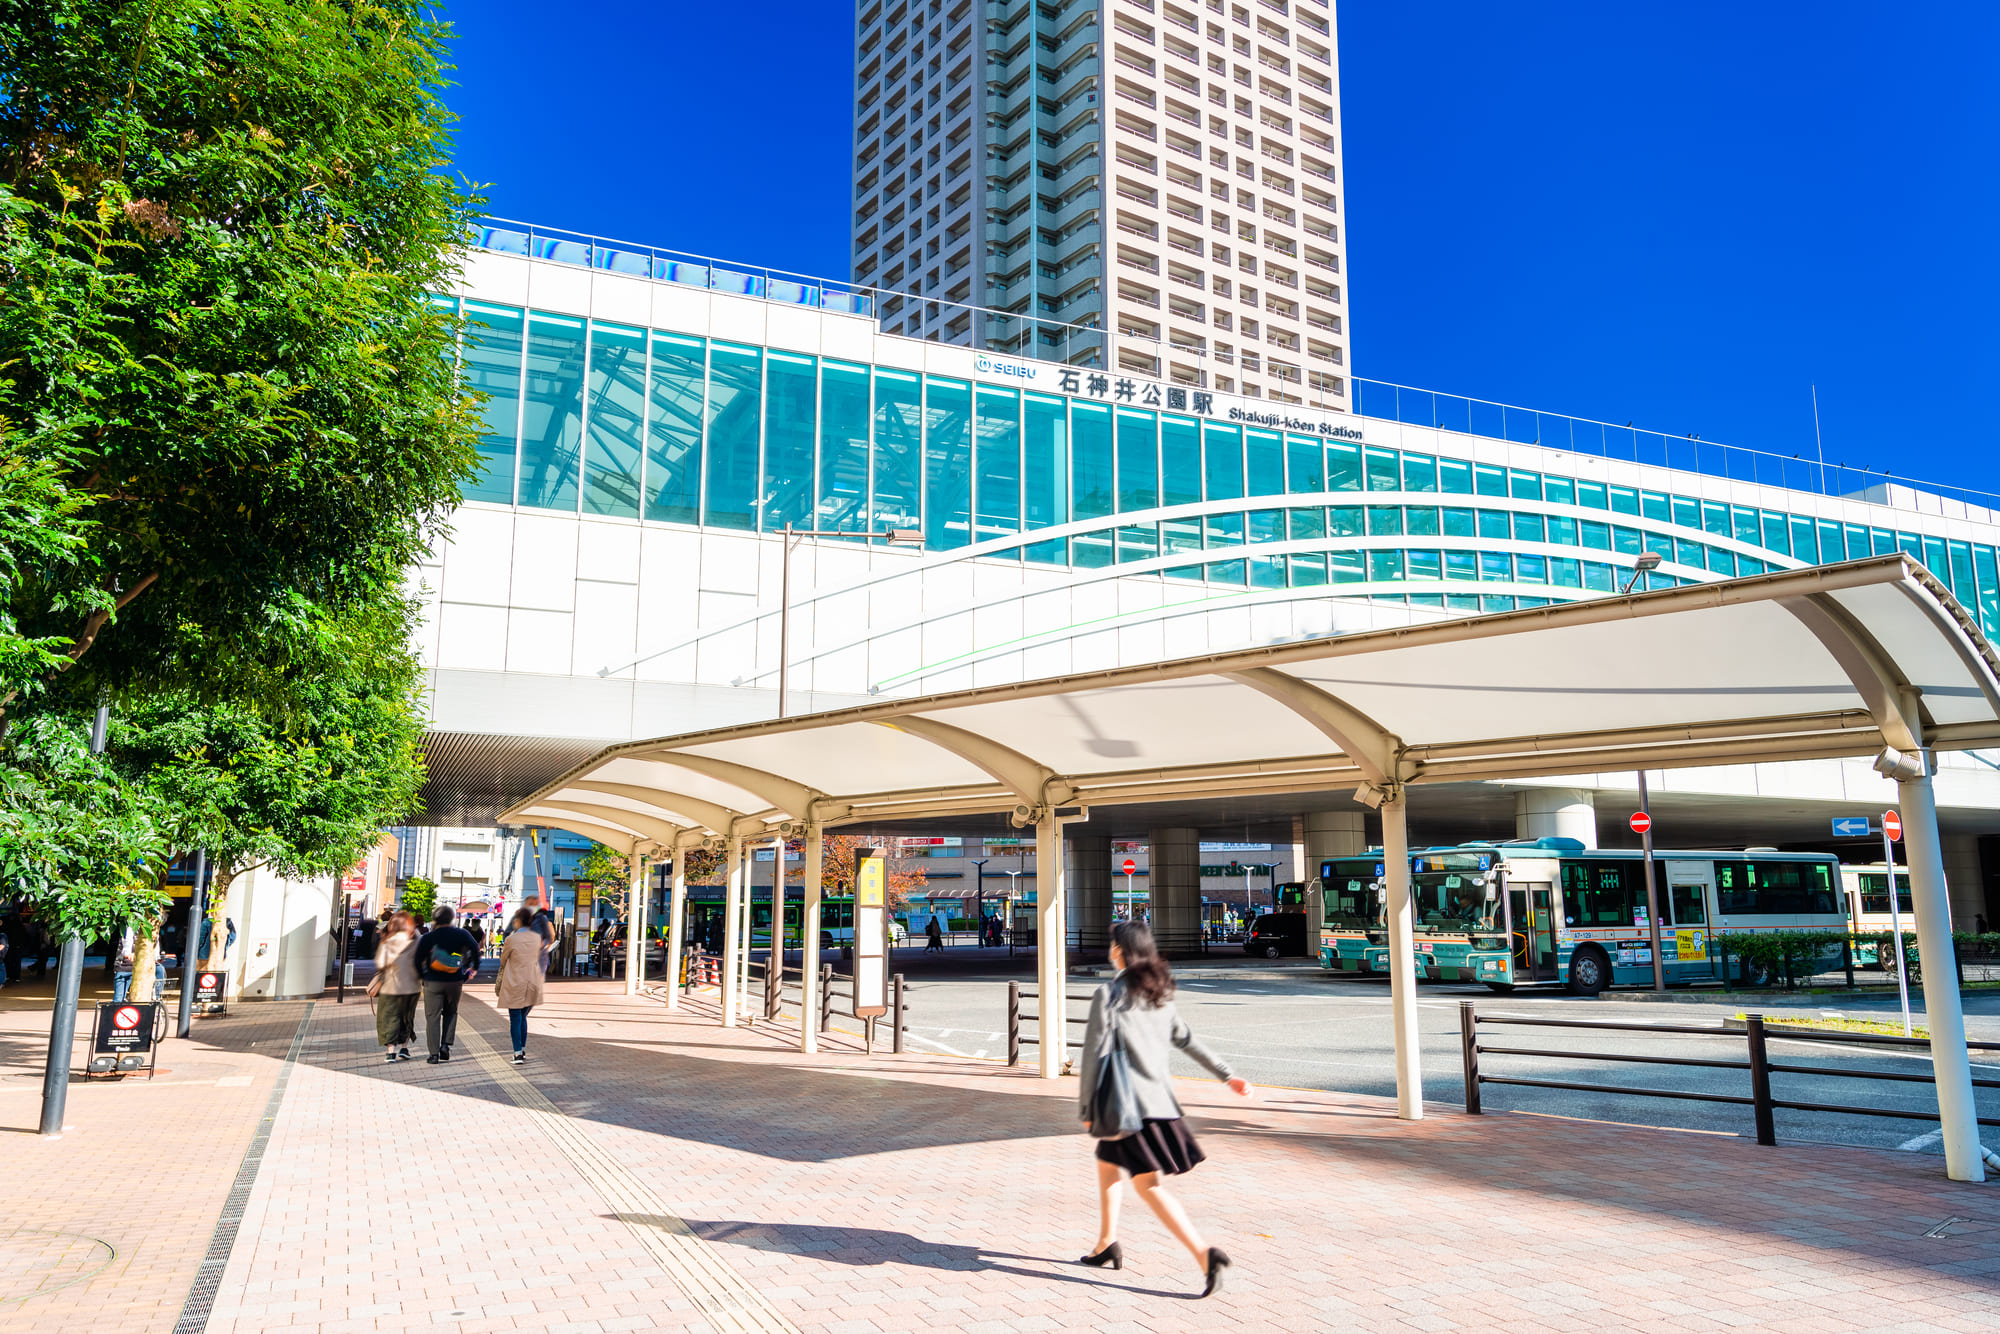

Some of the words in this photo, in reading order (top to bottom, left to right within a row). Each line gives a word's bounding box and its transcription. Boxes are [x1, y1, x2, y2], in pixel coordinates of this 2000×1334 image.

[994, 363, 1036, 379] SEIBU
[1058, 368, 1214, 415] 石神井公園駅
[1229, 407, 1315, 432] Shakujii-kōen
[1319, 422, 1363, 440] Station
